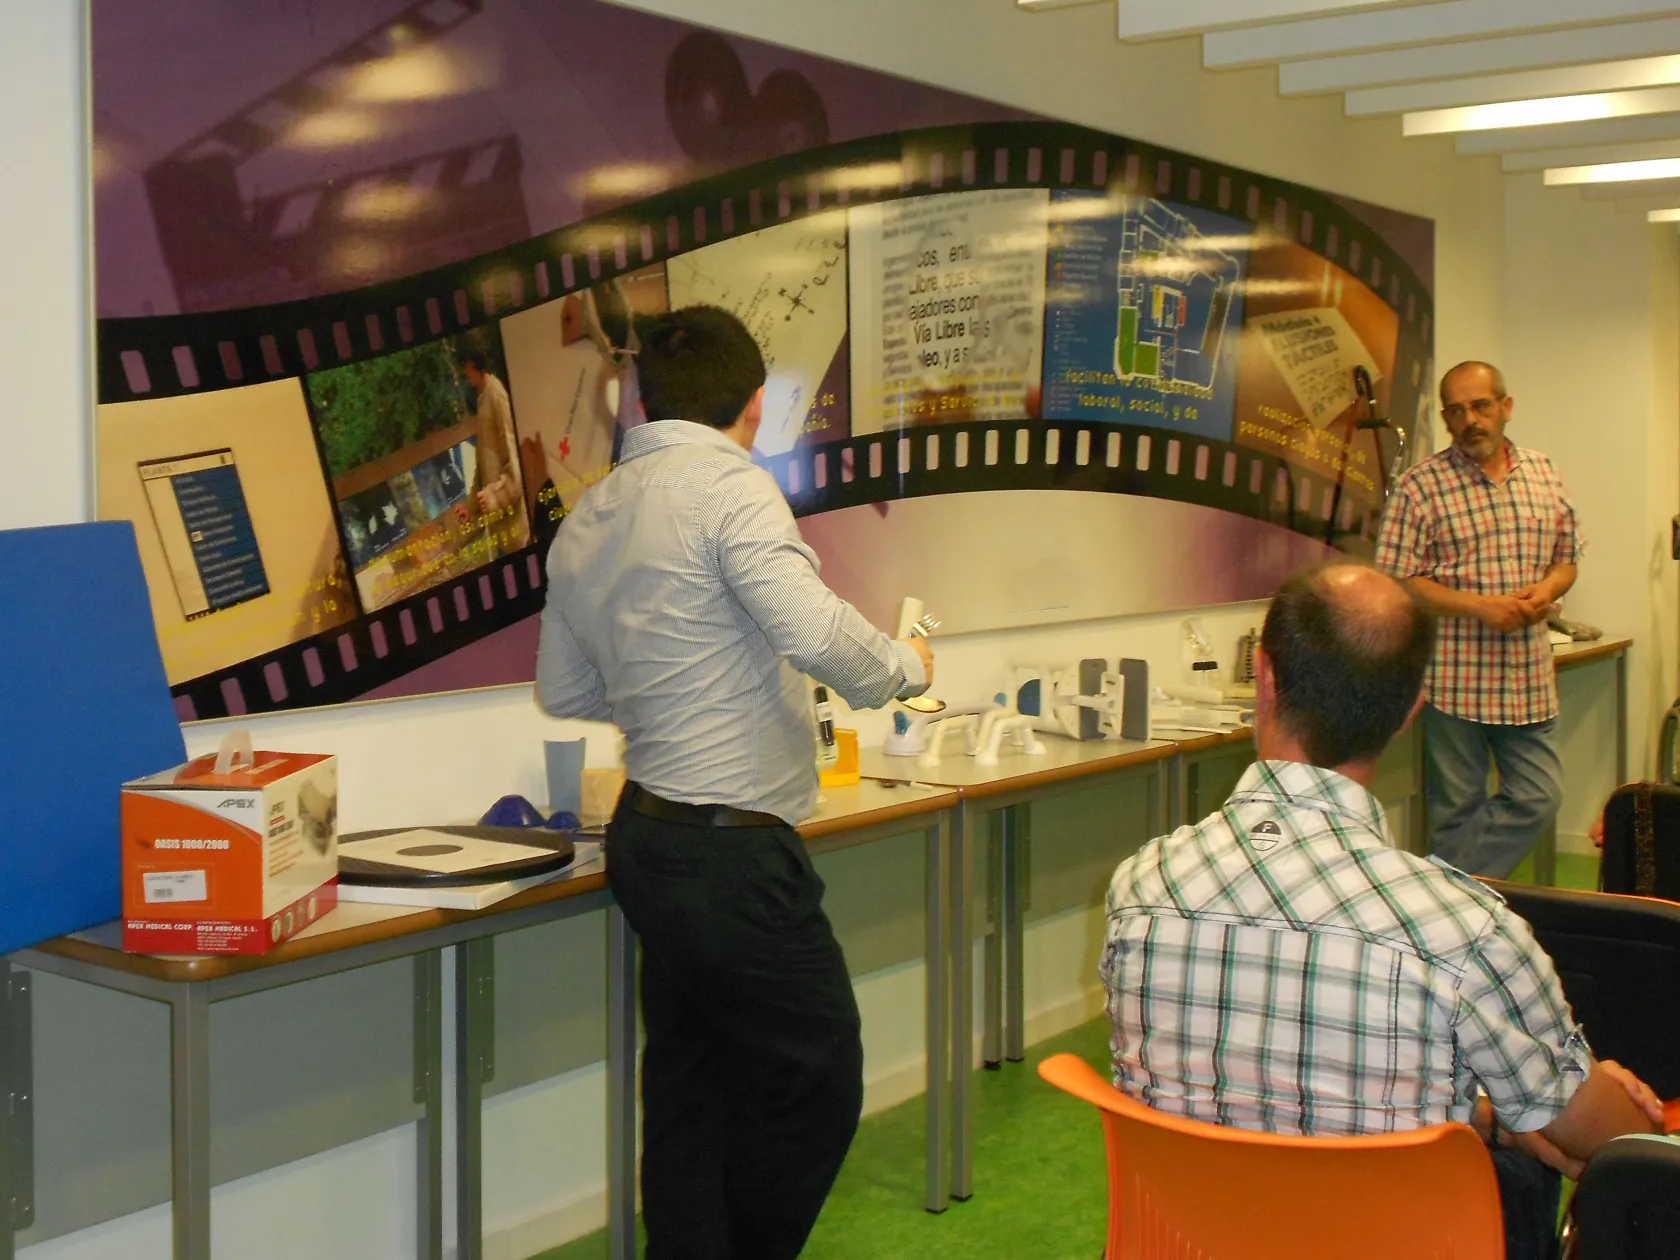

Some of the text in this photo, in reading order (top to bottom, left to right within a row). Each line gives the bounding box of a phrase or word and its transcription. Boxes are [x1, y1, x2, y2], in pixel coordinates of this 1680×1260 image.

[935, 320, 965, 340] Libre
[217, 799, 256, 809] APEX
[155, 839, 230, 850] OASIS 1000/2000
